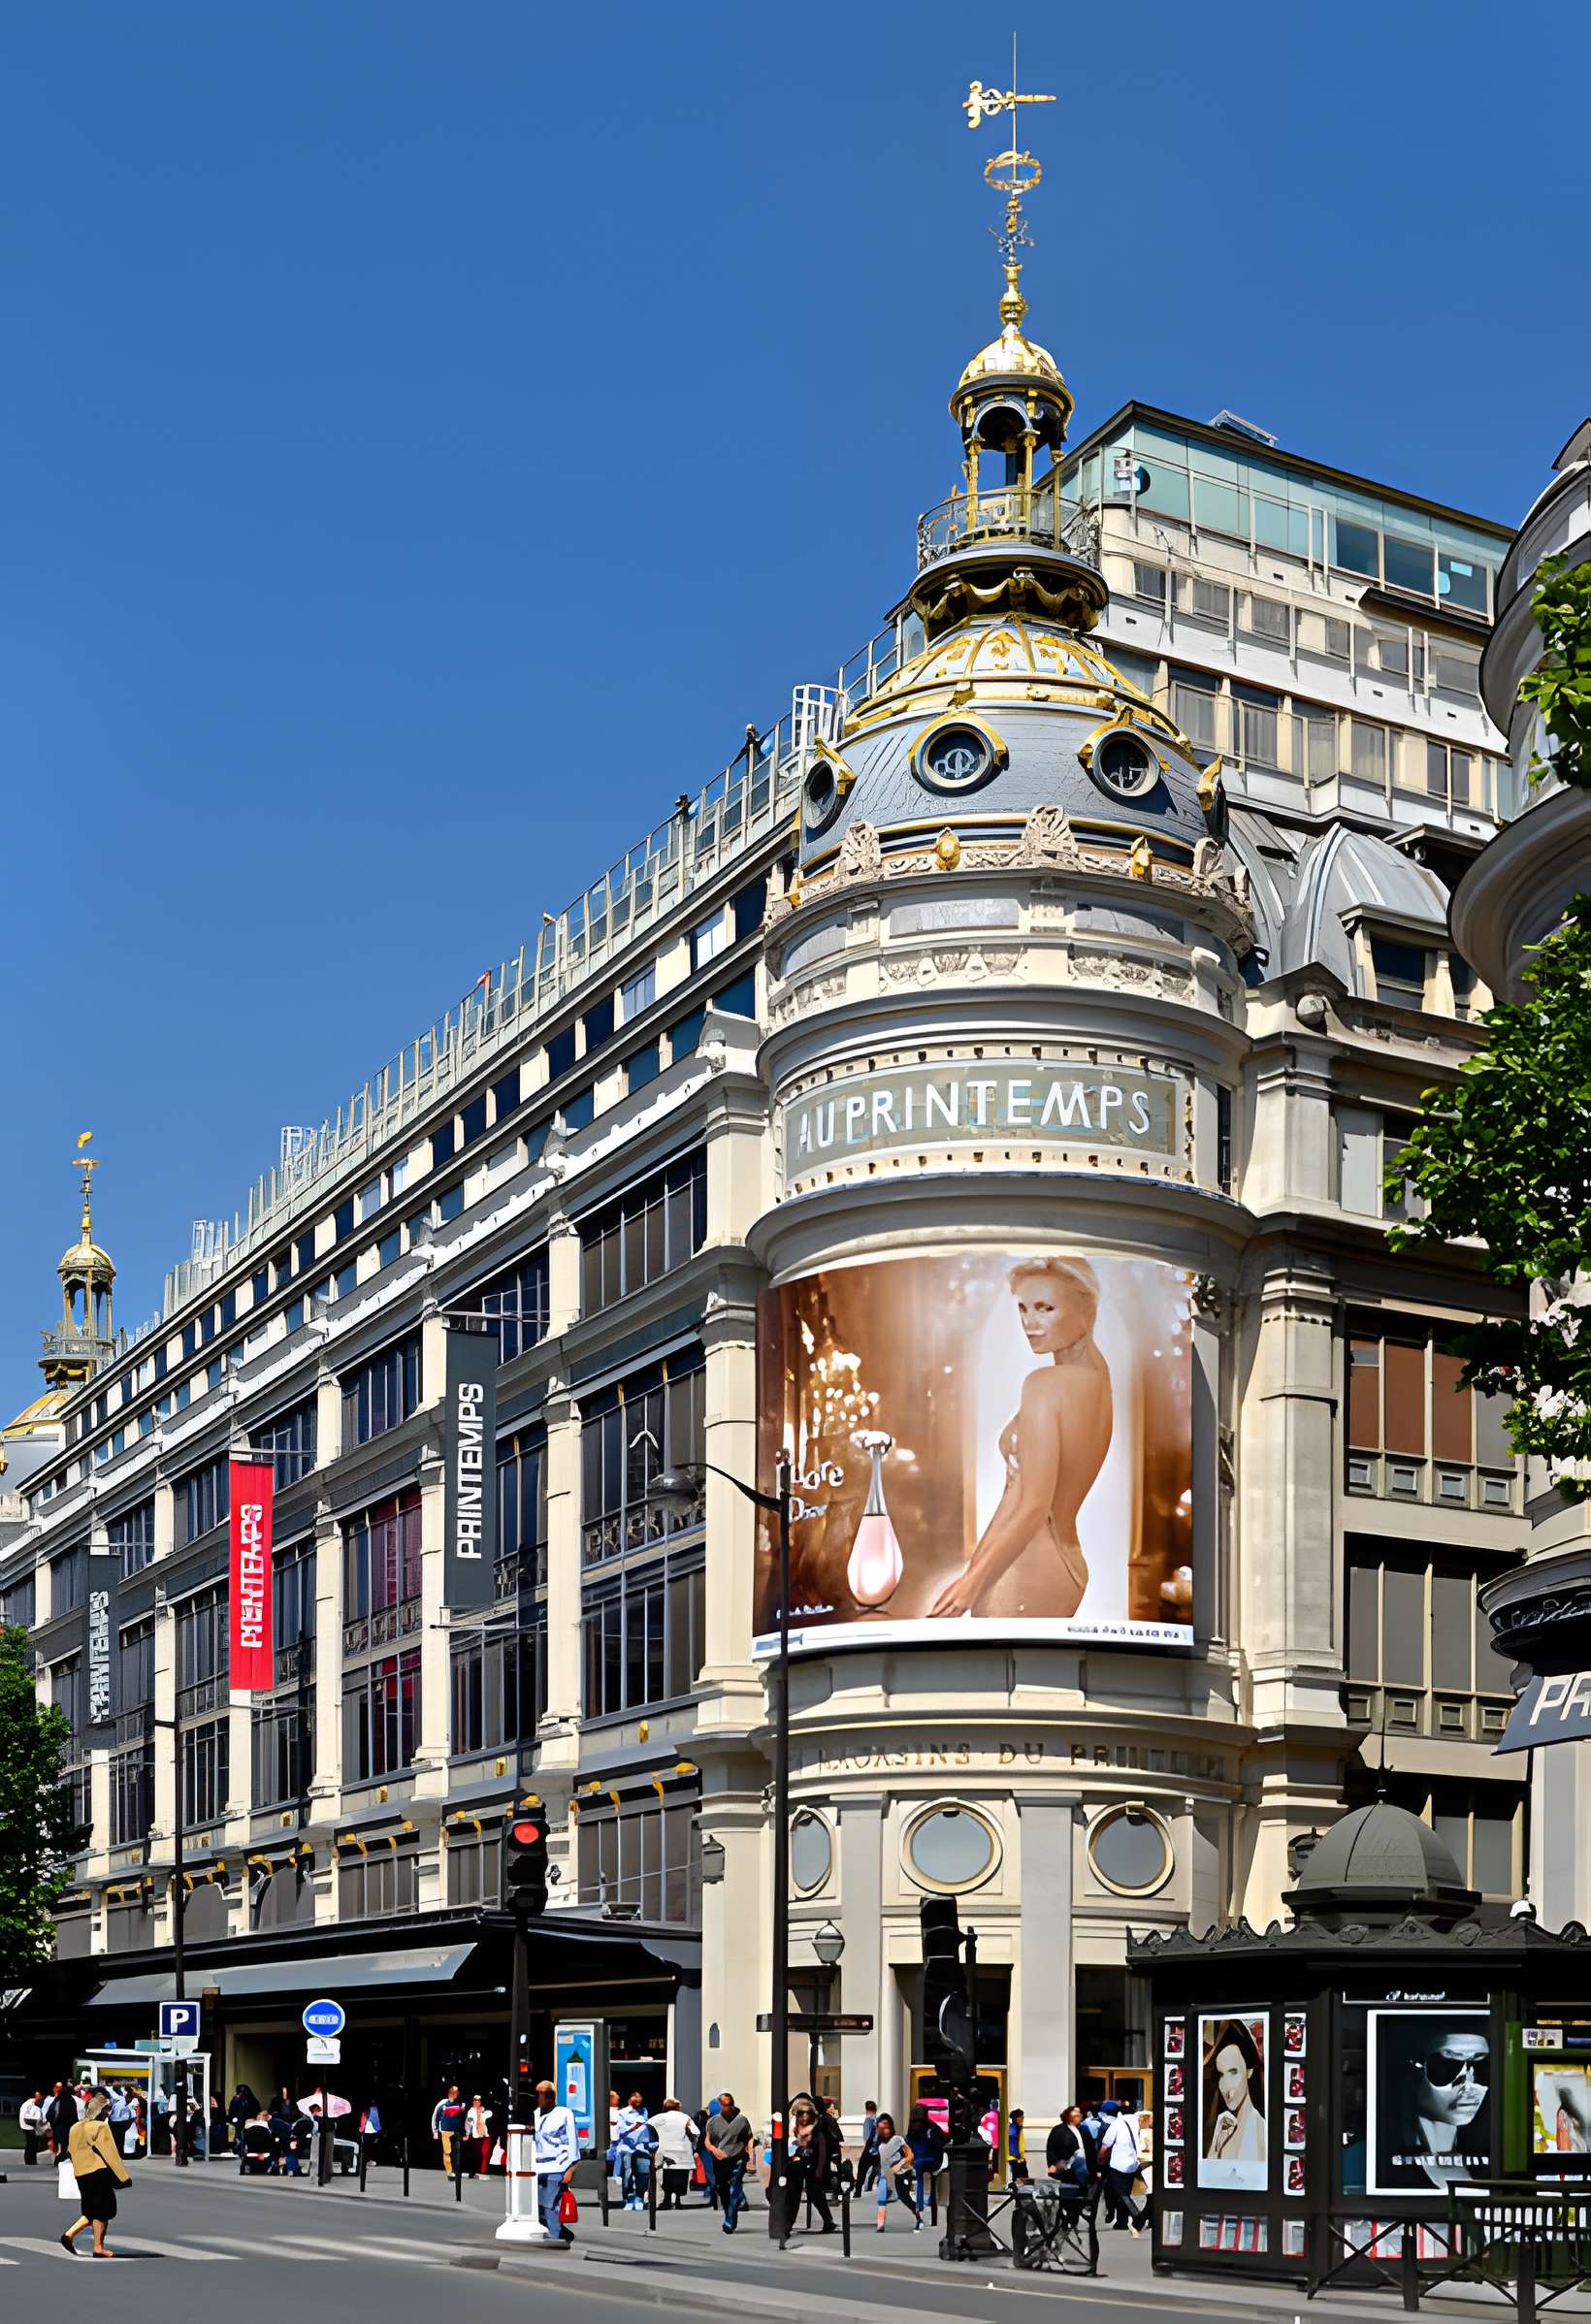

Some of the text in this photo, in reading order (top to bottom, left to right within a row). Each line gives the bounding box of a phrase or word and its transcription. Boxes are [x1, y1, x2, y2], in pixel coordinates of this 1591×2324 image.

[846, 1080, 1150, 1145] PRINTEMPS
[457, 1382, 484, 1559] PRINTEMPS
[998, 1743, 1044, 1765] DU
[170, 2009, 190, 2034] P
